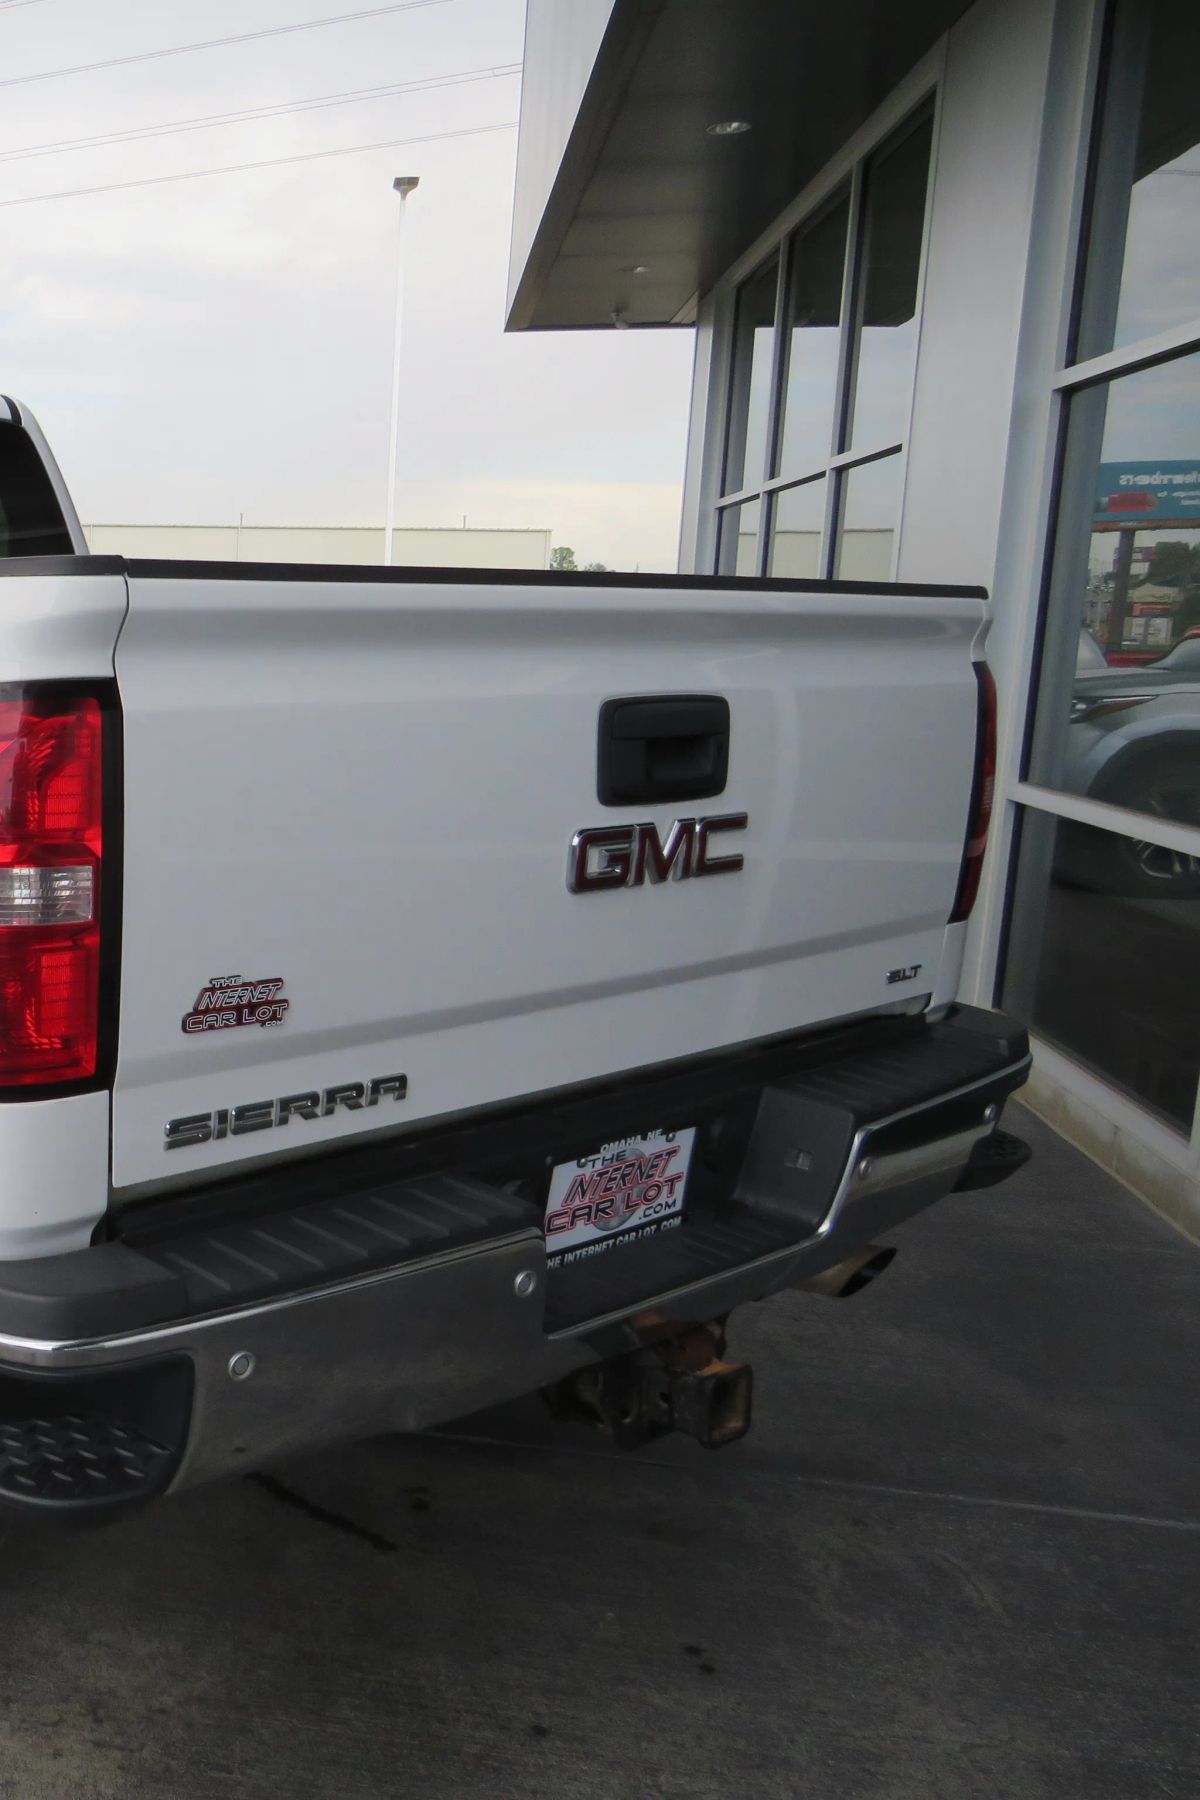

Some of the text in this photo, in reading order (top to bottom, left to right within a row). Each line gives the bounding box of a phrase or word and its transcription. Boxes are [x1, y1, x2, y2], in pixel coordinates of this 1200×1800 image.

[566, 811, 749, 895] GMC
[198, 981, 283, 1010] INTERNET
[211, 976, 243, 988] THE
[186, 1003, 288, 1031] CAR LOT
[164, 1072, 408, 1151] SIERRA
[588, 1150, 627, 1168] THE
[561, 1146, 681, 1207] INTERNET
[544, 1172, 685, 1236] CAR LOT
[639, 1198, 676, 1220] .COM
[546, 1256, 561, 1269] HE
[564, 1237, 617, 1264] INTERNET
